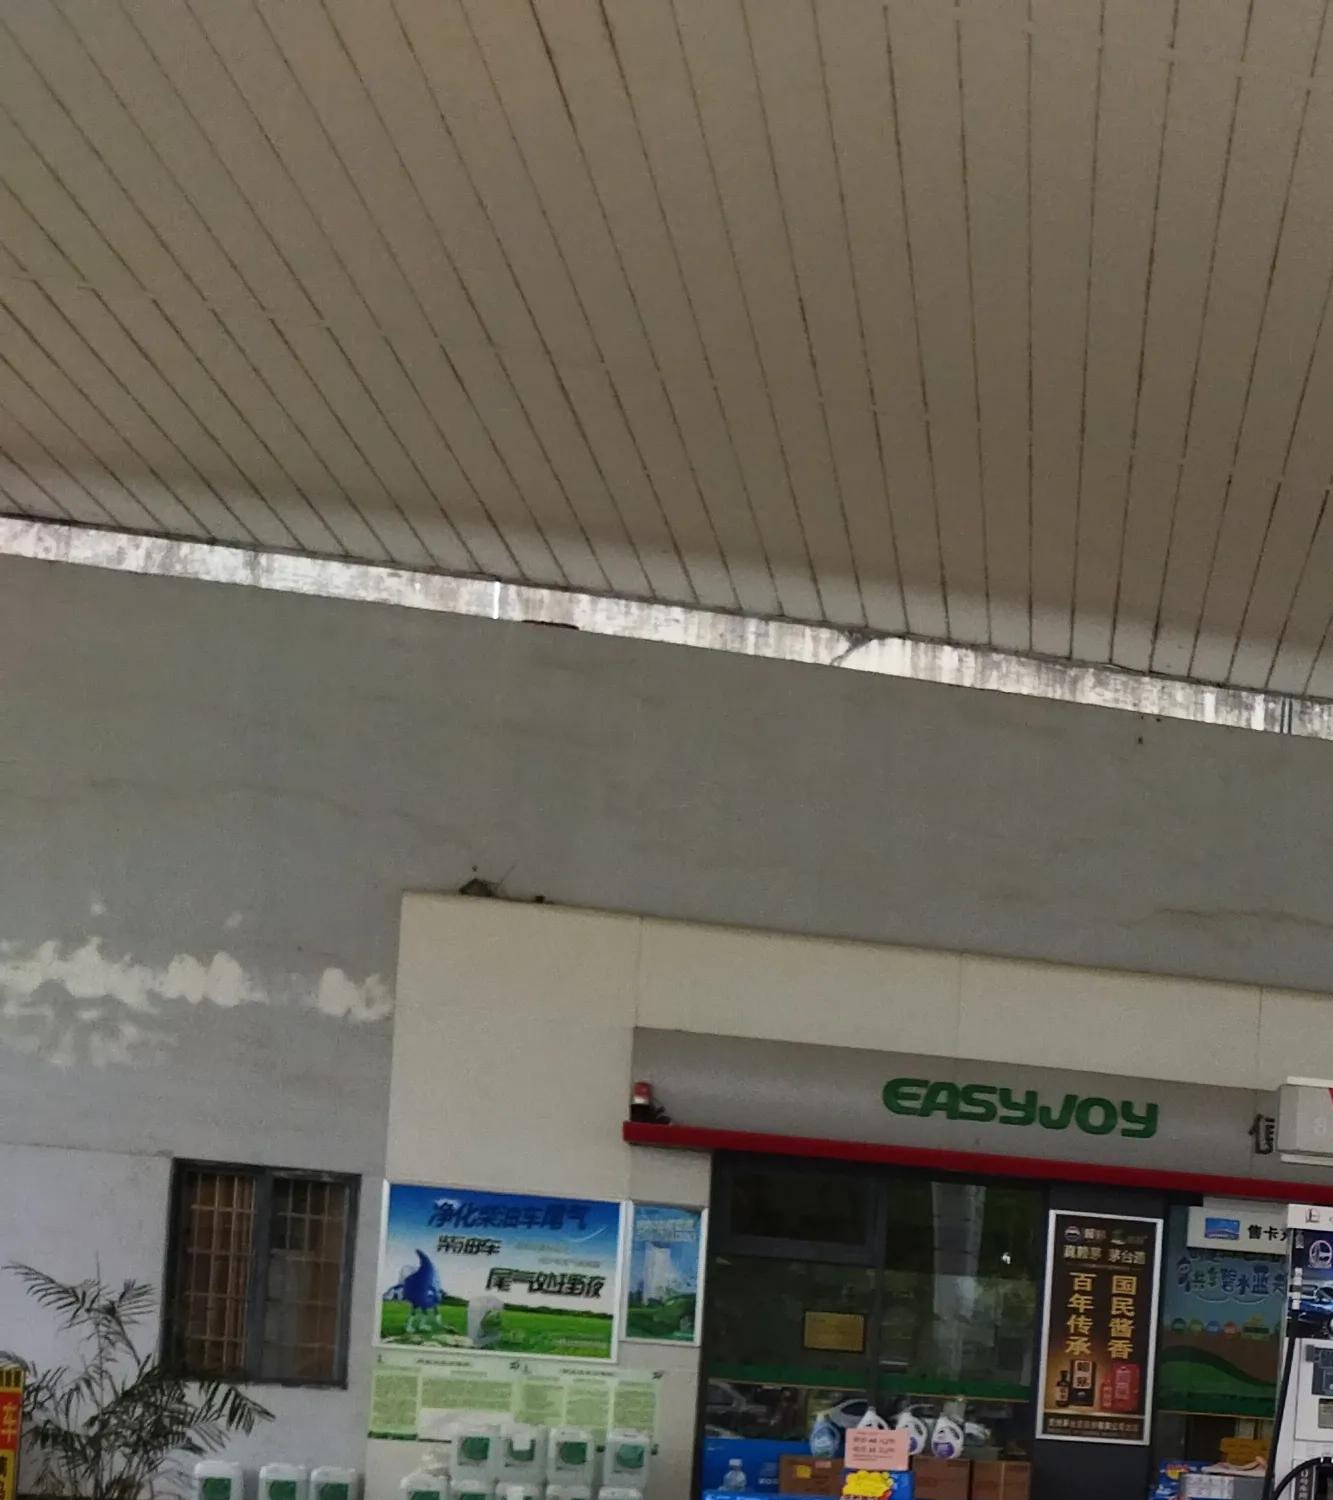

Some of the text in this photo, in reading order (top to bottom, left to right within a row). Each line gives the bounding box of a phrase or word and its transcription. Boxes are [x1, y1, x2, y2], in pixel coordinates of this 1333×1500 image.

[882, 1077, 1160, 1140] EASYJOY
[1064, 1271, 1098, 1357] 百年传承
[1107, 1274, 1138, 1360] 国民酱香
